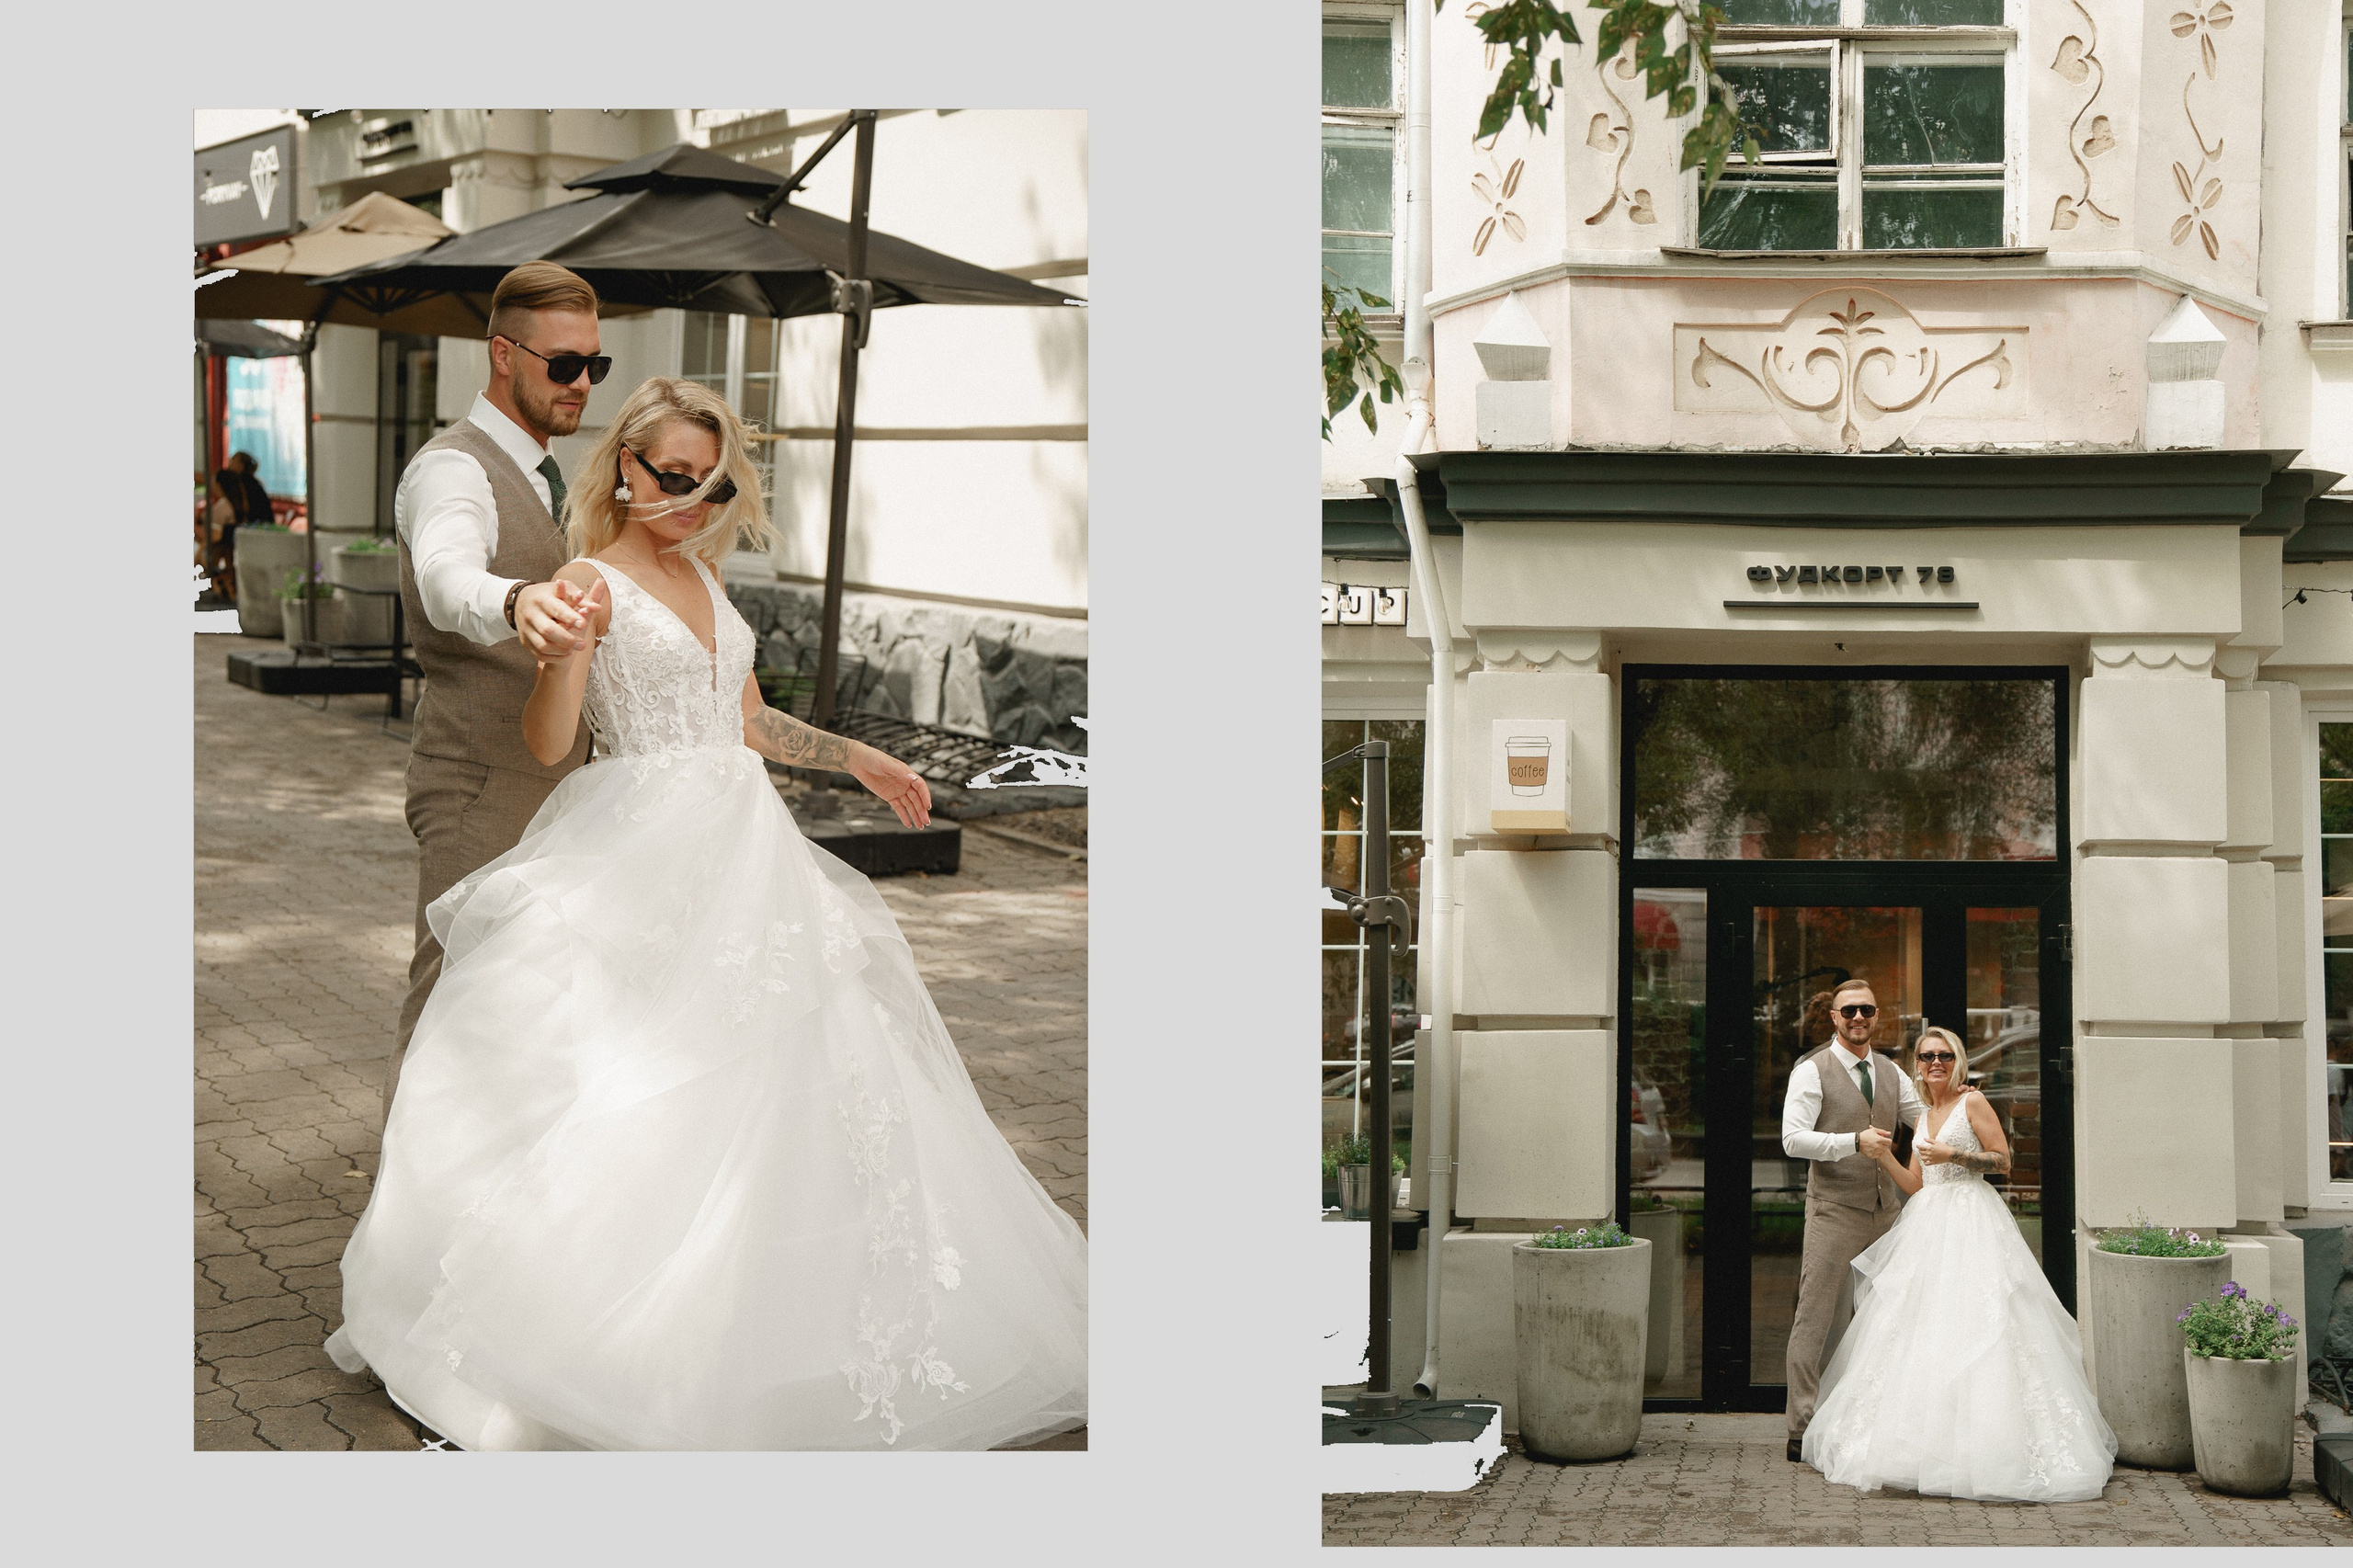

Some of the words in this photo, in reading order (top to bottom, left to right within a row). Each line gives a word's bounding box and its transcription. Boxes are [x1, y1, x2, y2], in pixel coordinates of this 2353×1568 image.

[1746, 565, 1904, 583] ФУДКОРТ
[1916, 566, 1954, 583] 78
[1510, 764, 1545, 778] coffee
